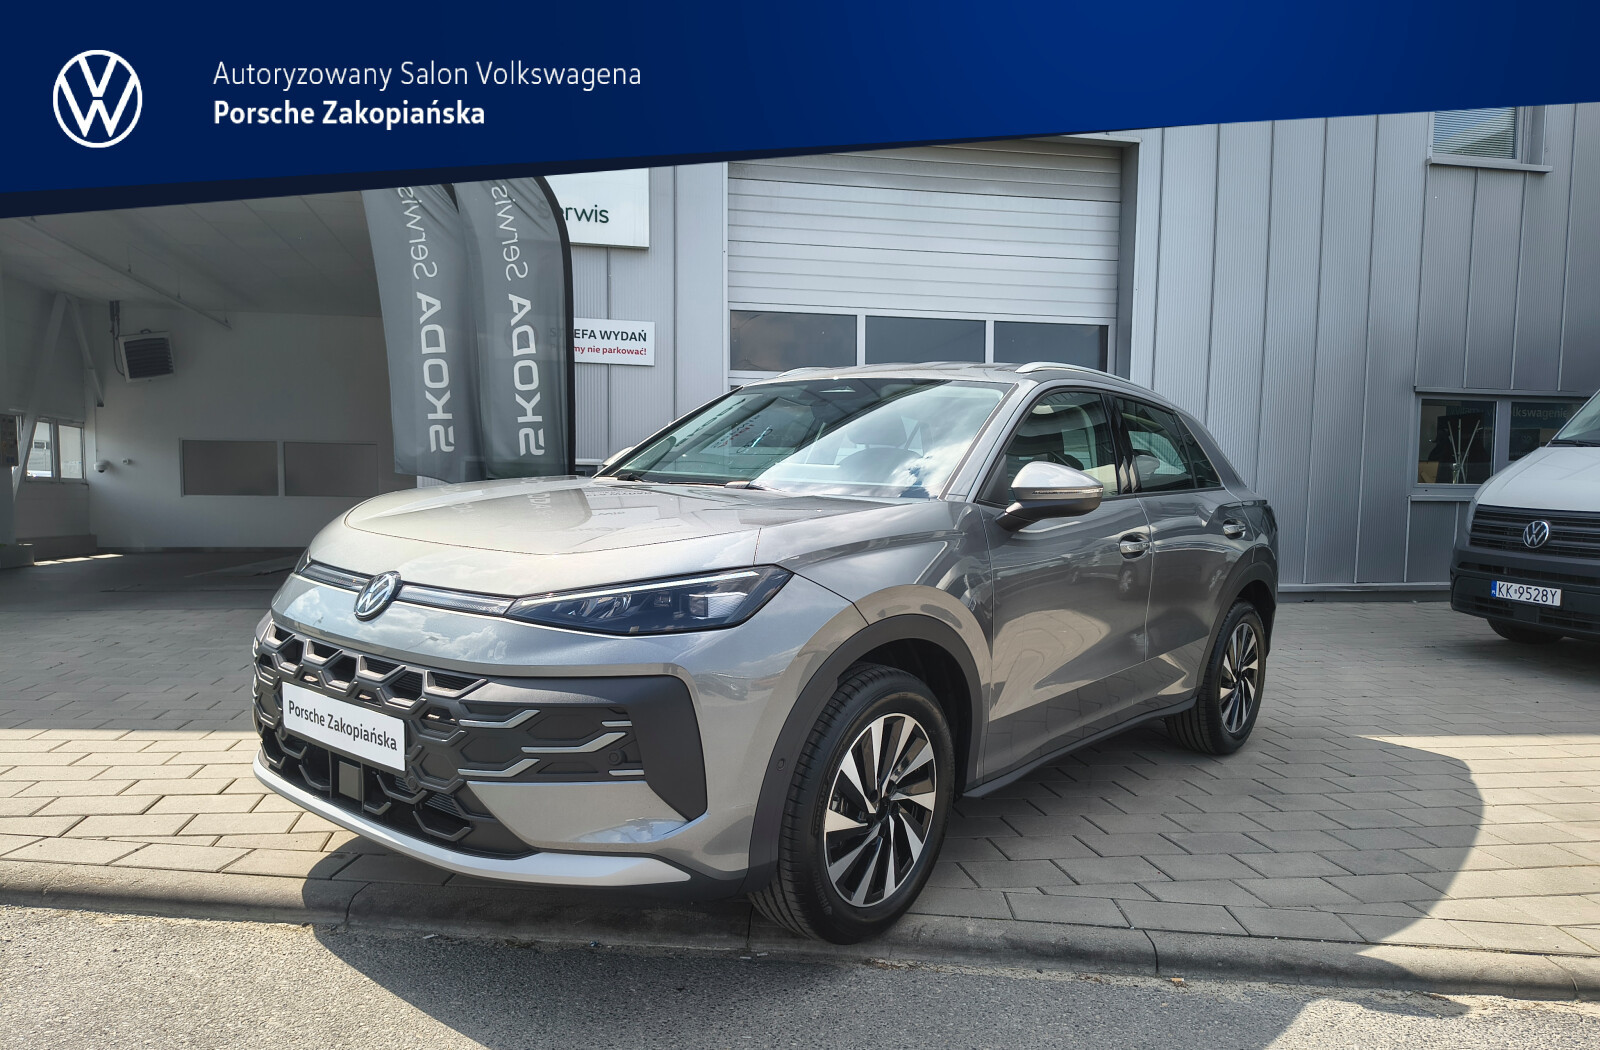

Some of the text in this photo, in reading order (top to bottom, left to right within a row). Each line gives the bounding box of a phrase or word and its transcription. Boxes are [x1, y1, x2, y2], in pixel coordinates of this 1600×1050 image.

[564, 204, 610, 224] rwis
[599, 329, 647, 342] WYDAŃ
[587, 345, 601, 354] nie
[602, 346, 647, 356] parkować!
[1498, 582, 1558, 604] KK 9528Y
[288, 699, 398, 751] Porsche Zakopiańska
